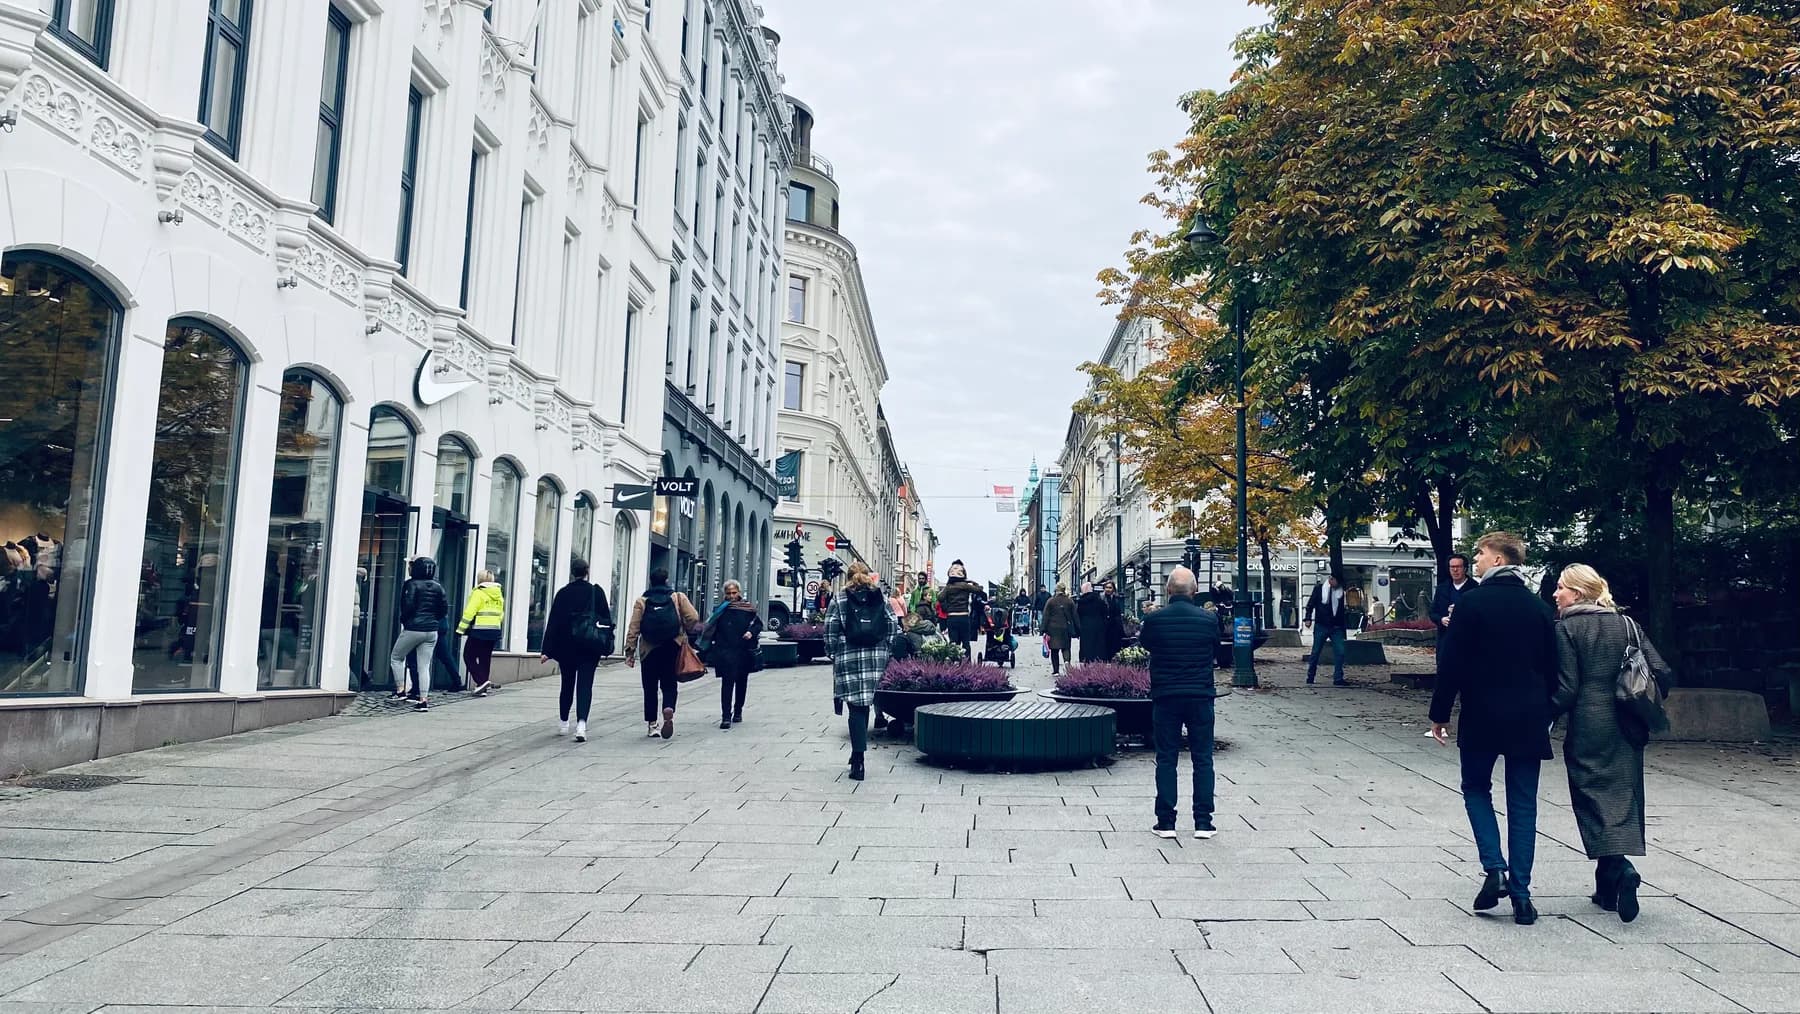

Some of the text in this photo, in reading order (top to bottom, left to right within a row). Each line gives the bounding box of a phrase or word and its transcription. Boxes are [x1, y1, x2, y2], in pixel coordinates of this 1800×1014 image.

[660, 481, 694, 492] VOLT
[680, 495, 695, 519] VOLT
[809, 584, 818, 592] 30
